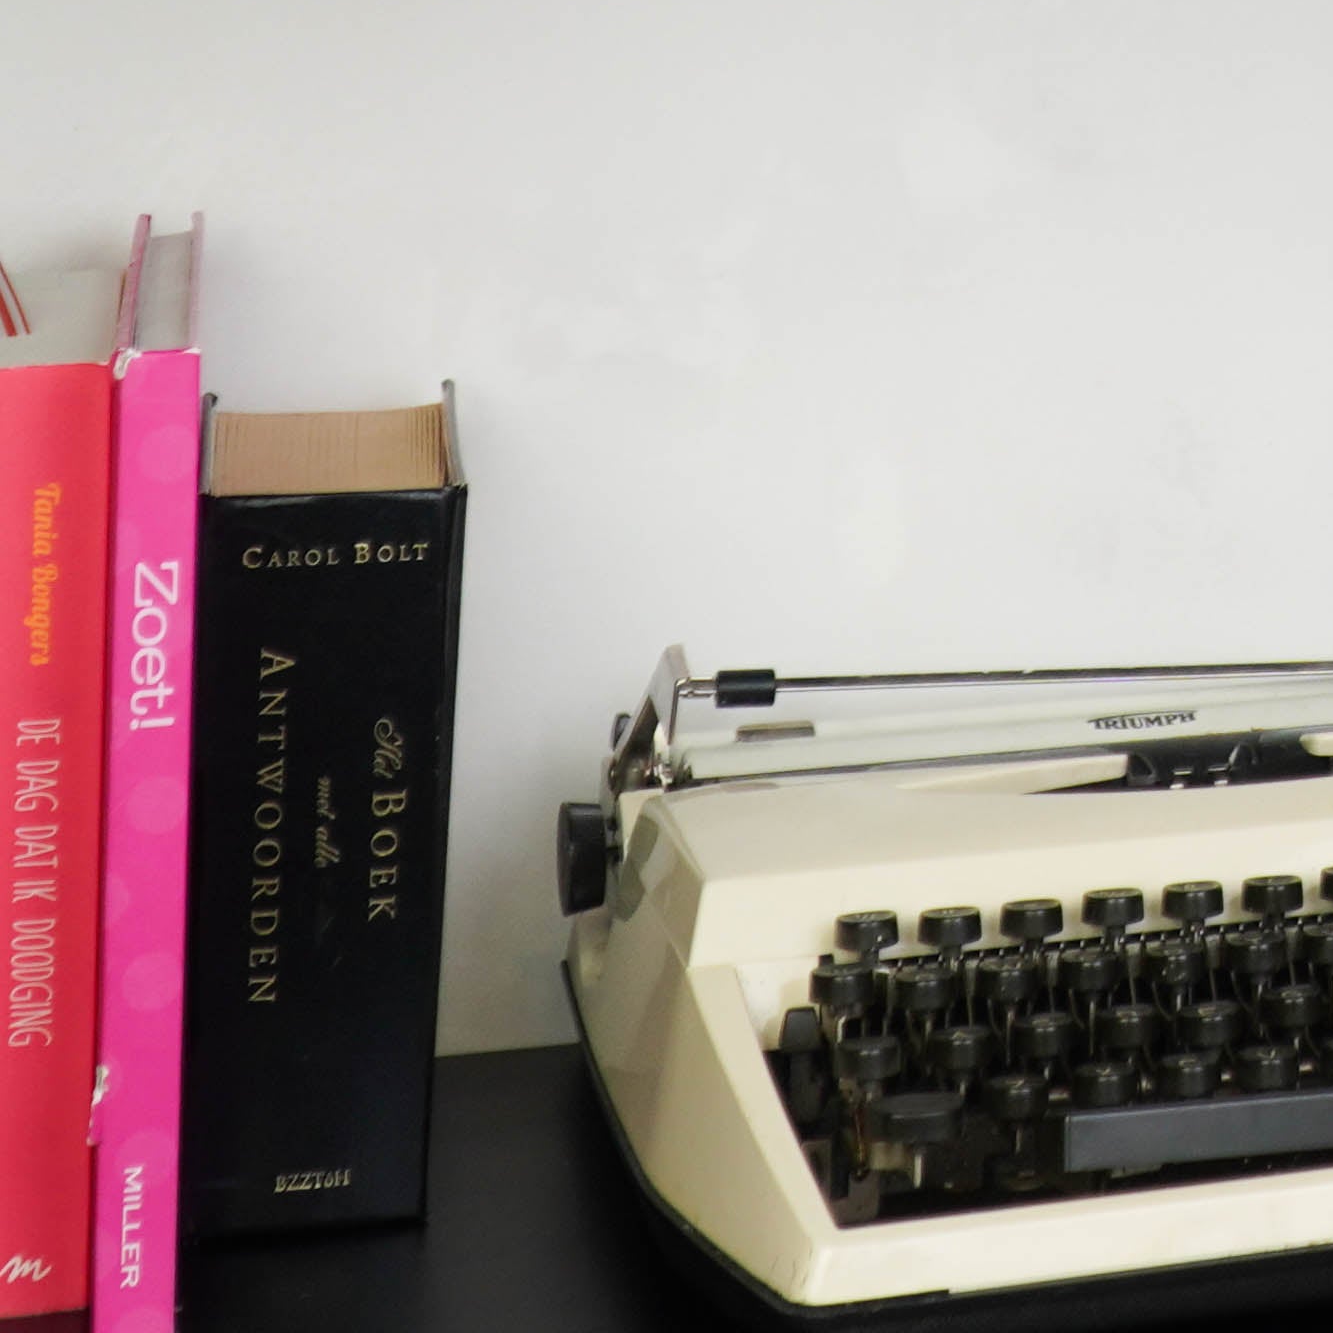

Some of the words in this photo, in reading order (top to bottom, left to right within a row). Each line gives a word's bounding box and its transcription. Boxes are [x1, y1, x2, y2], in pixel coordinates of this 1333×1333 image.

[23, 563, 58, 666] Bongers
[129, 560, 180, 731] Zoet!
[16, 718, 61, 747] DE
[1088, 710, 1197, 730] TRIUMPH
[14, 759, 60, 812] DAG
[14, 824, 59, 868] DAT
[12, 879, 57, 903] IK
[8, 918, 56, 1048] DOODGING
[120, 1165, 145, 1289] MILLER
